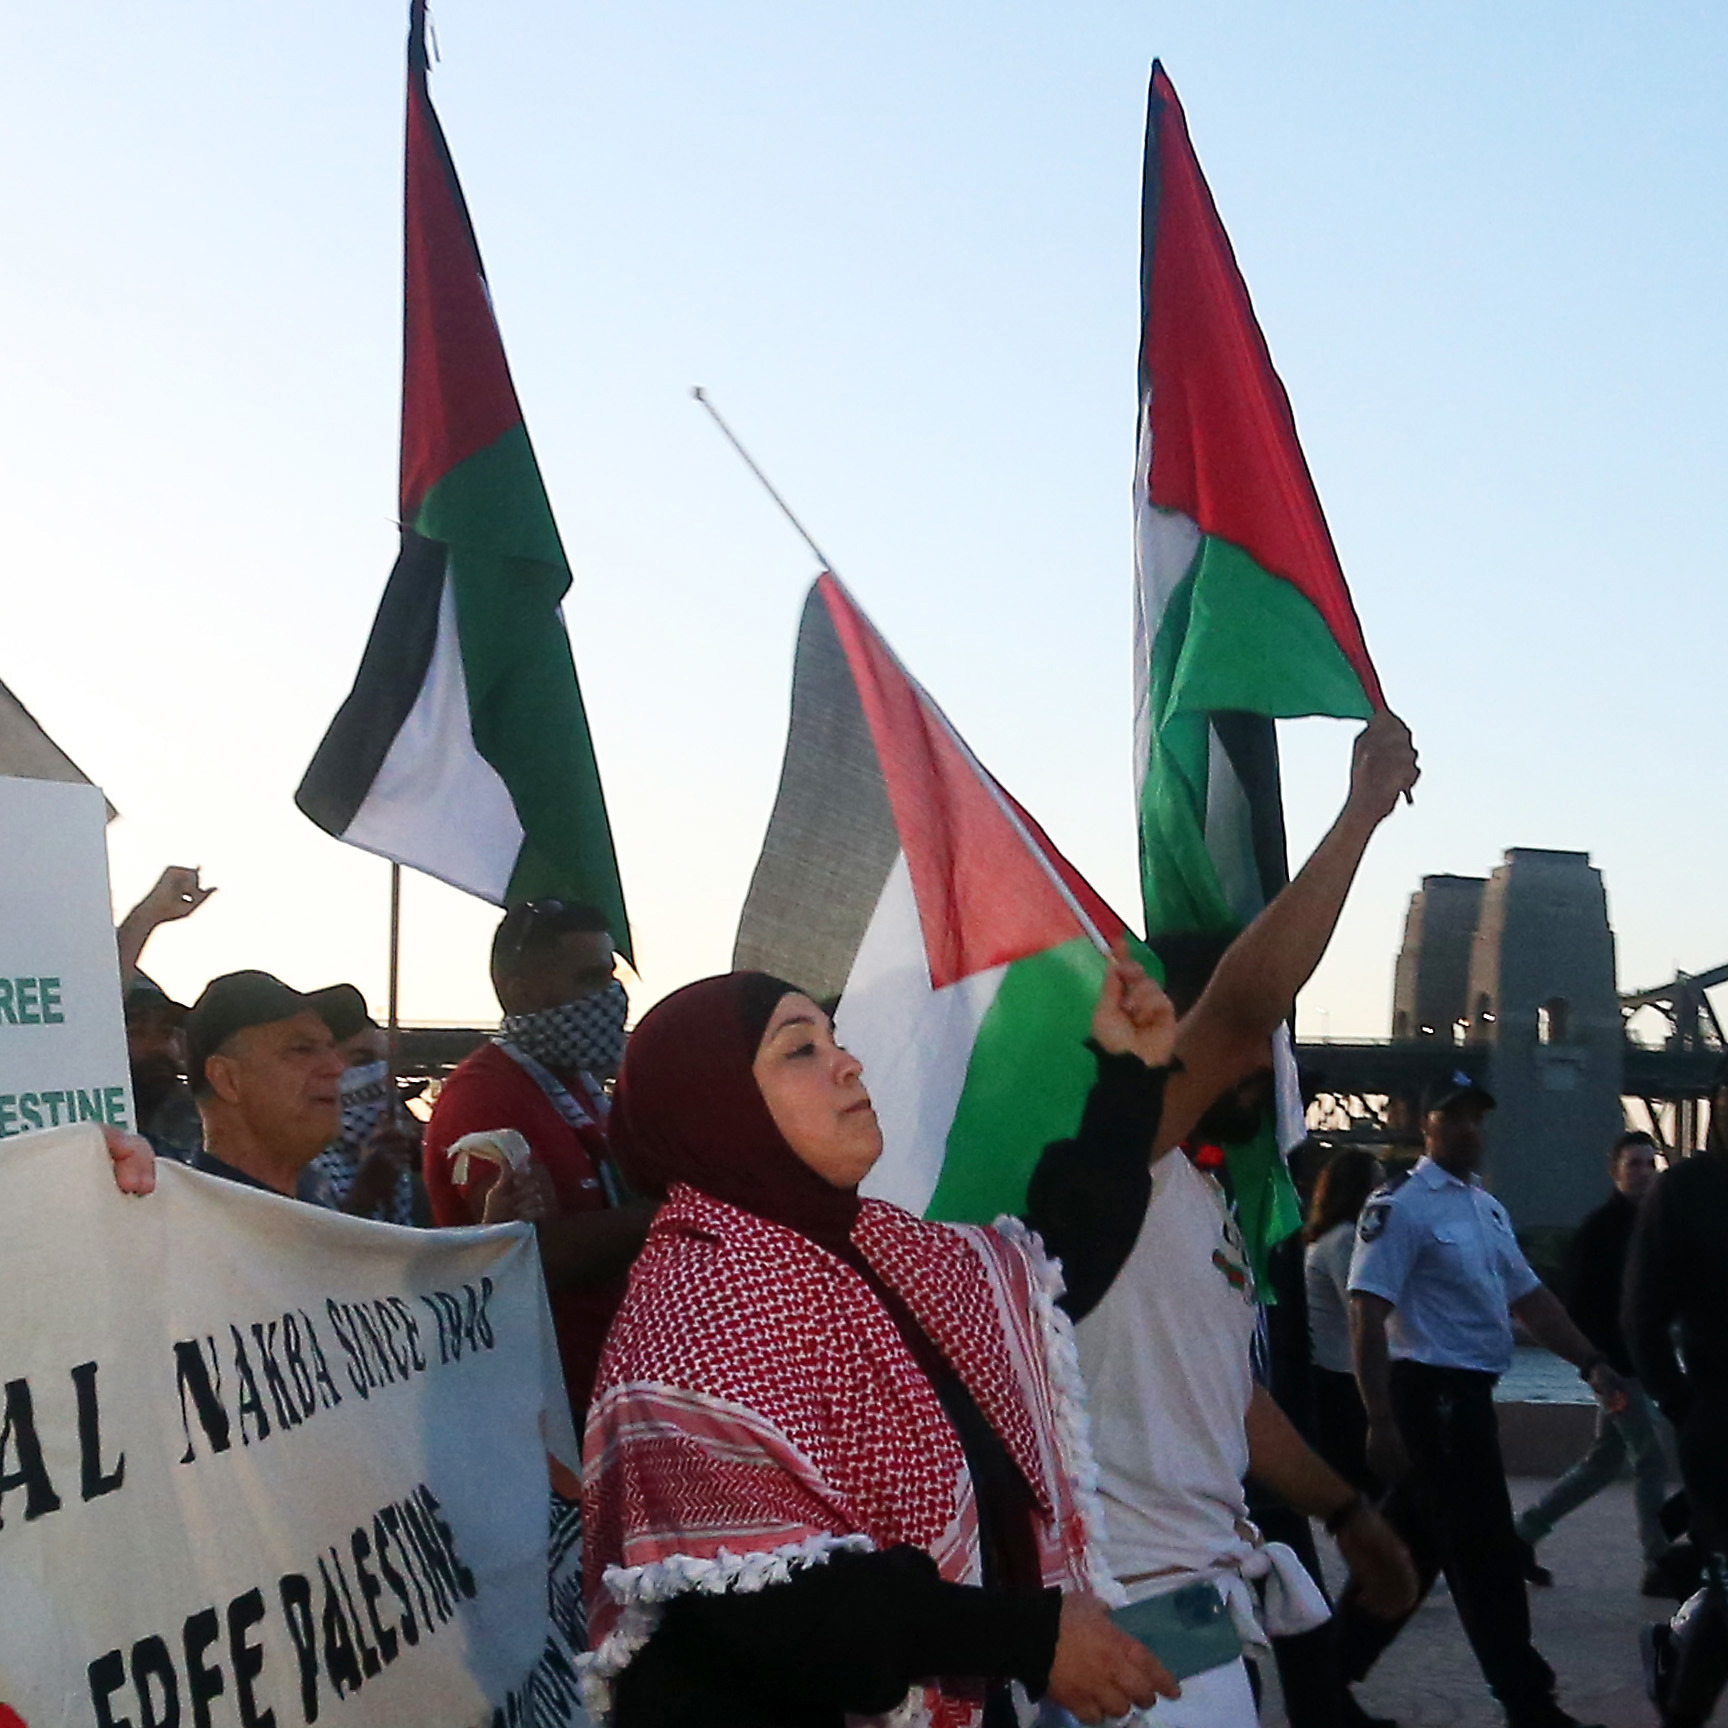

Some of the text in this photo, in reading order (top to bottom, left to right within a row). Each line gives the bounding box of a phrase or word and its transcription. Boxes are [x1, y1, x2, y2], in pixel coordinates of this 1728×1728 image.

[174, 1309, 342, 1464] NAKBA
[326, 1297, 425, 1400] SINCE
[421, 1276, 493, 1365] 1948
[280, 1484, 476, 1724] PALESTINE
